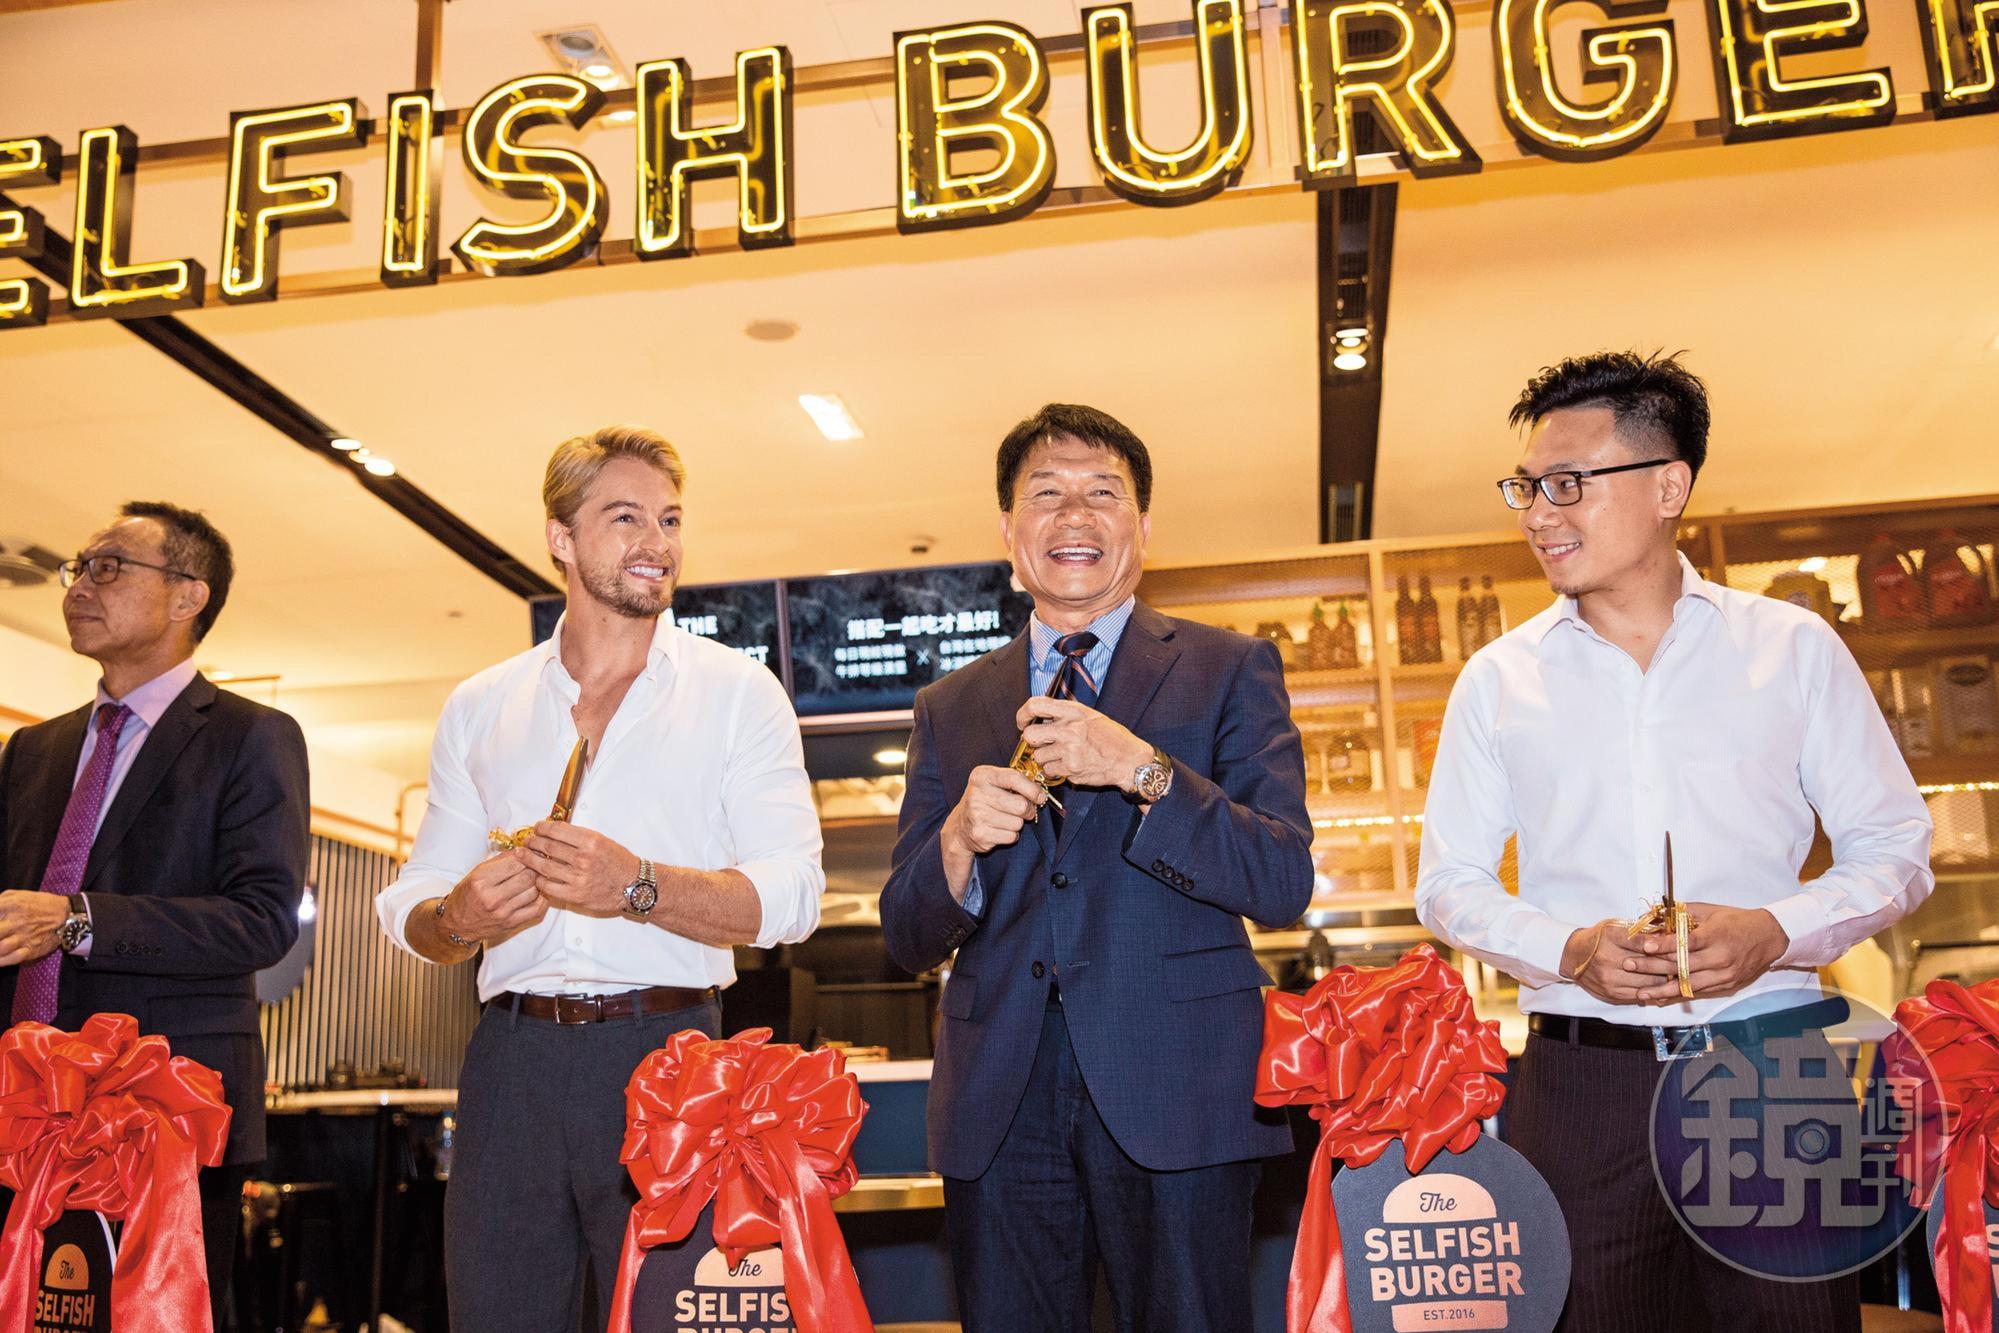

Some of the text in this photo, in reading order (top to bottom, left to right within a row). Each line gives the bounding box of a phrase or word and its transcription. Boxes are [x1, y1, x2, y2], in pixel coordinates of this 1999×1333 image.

[1419, 1192, 1458, 1213] The
[1364, 1221, 1521, 1262] SELFISH
[60, 1261, 75, 1279] The
[728, 1258, 762, 1277] The
[1370, 1262, 1525, 1301] BURGER
[35, 1290, 95, 1327] SELFISH
[674, 1289, 792, 1323] SELFIS
[1423, 1309, 1475, 1320] EST.2016
